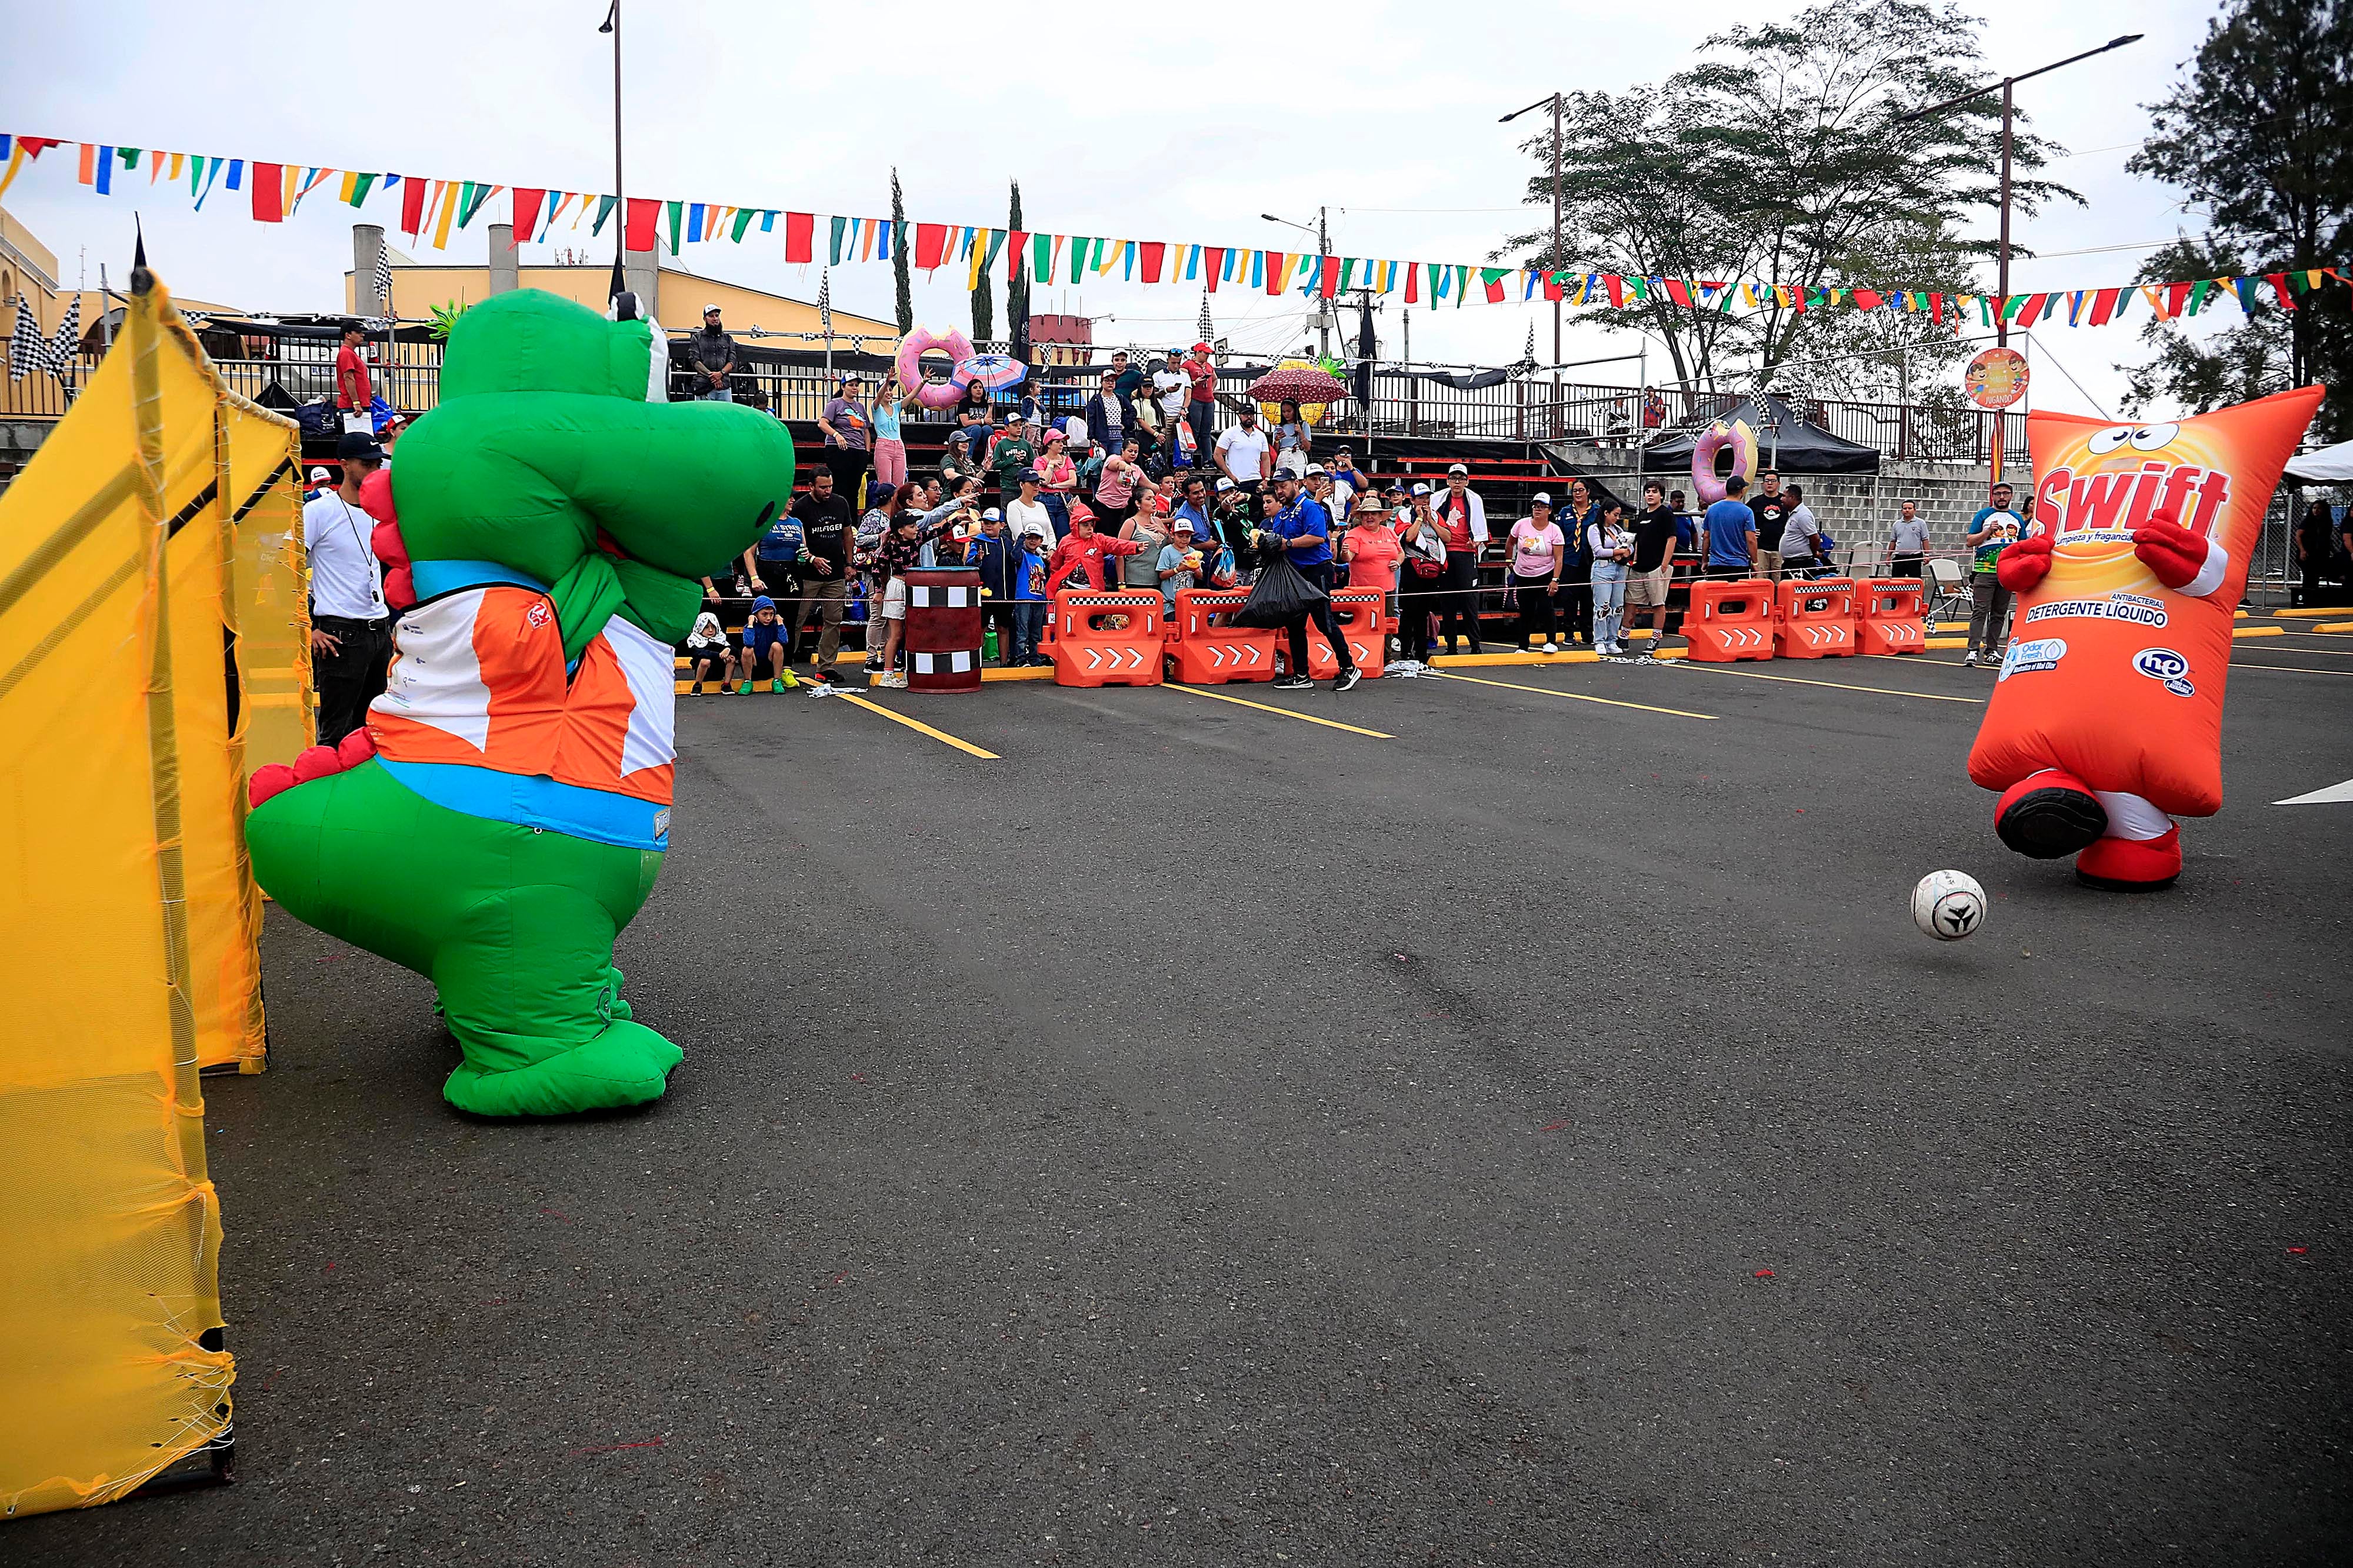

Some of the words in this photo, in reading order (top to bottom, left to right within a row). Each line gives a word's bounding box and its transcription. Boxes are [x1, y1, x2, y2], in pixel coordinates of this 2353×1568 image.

[1985, 395, 2012, 405] JUGANDO
[2032, 462, 2228, 539] Swift
[812, 523, 842, 534] HILFIGER
[2057, 534, 2085, 545] Limpieza
[2088, 534, 2093, 542] y
[2094, 531, 2133, 542] fragancia
[2111, 593, 2165, 608] ANTIBACTERIAL
[2027, 602, 2104, 621] DETERGENTE
[2105, 602, 2166, 626] LÍQUIDO
[2022, 643, 2044, 653] Odor
[2021, 651, 2042, 660] Fresh
